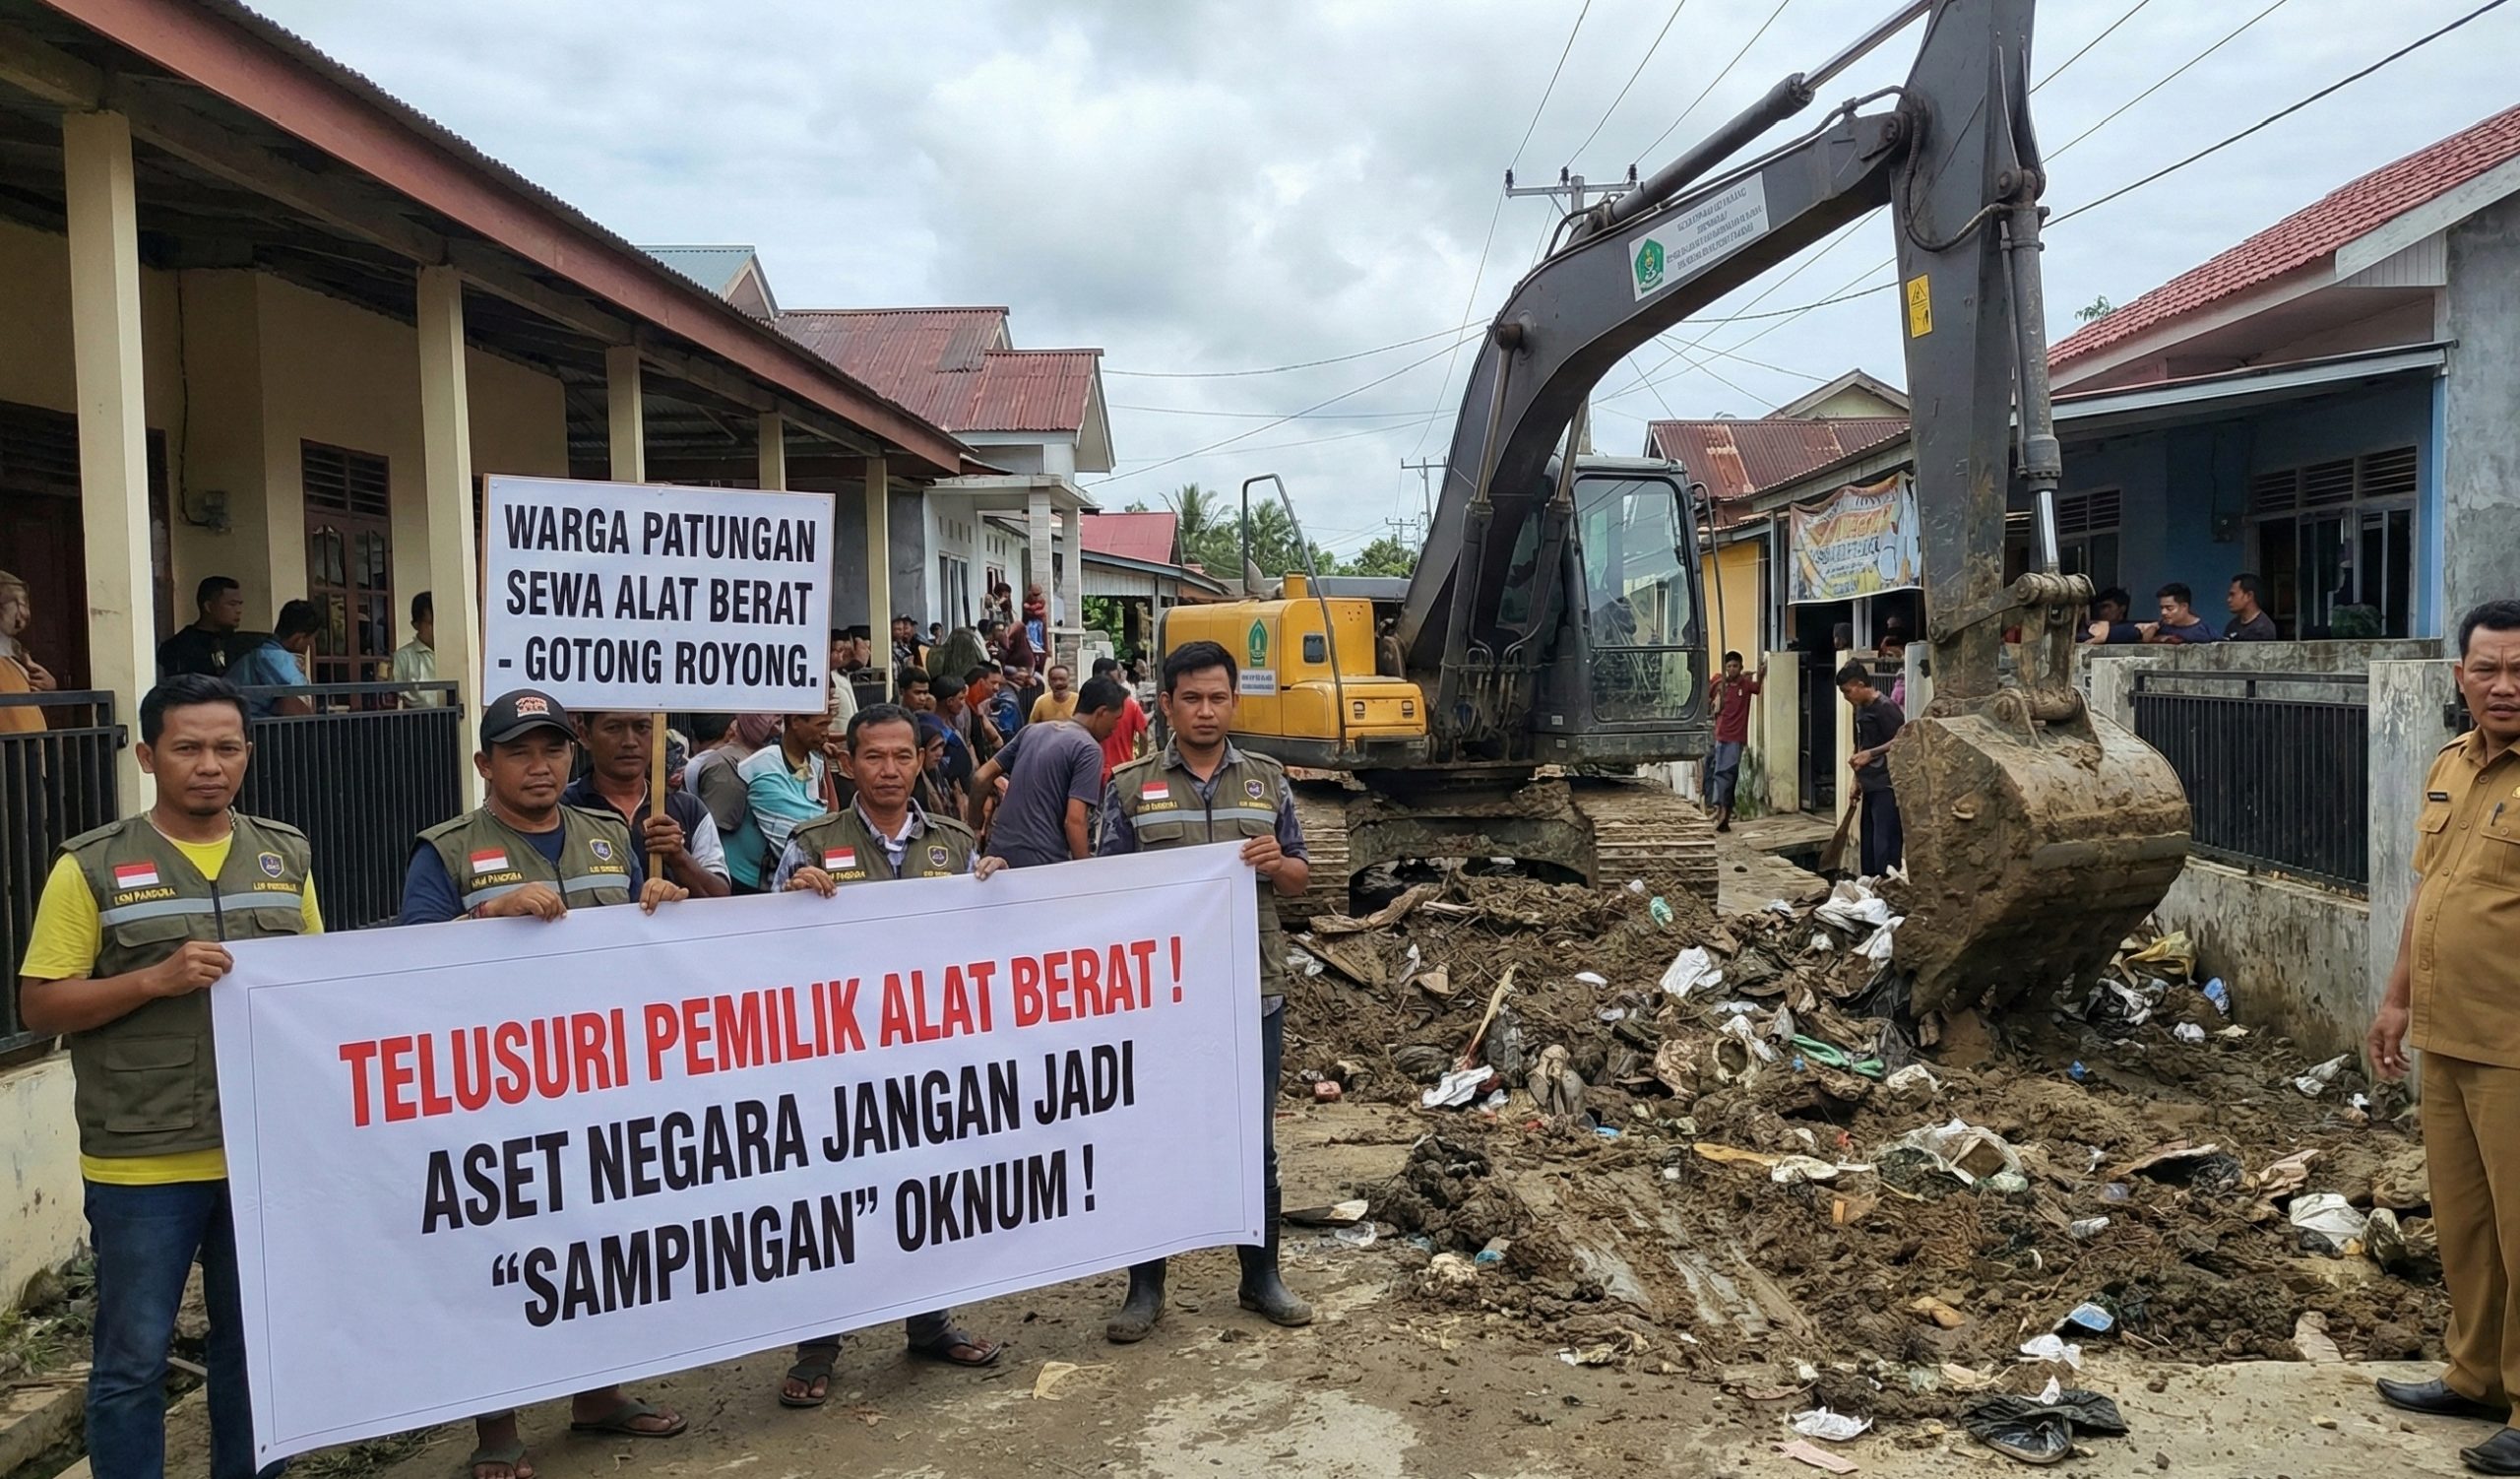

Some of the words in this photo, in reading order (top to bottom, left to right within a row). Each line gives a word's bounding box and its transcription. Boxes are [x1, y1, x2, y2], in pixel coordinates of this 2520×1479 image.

[504, 503, 630, 554] WARGA
[643, 511, 816, 563] PATUNGAN
[506, 568, 604, 619] SEWA
[614, 574, 699, 622] ALAT
[709, 578, 813, 626] BERAT
[525, 635, 662, 684] GOTONG
[674, 640, 818, 688] ROYONG.
[339, 1008, 629, 1127] TELUSURI
[644, 978, 865, 1081] PEMILIK
[879, 961, 996, 1046] ALAT
[1010, 939, 1157, 1028] BERAT
[1168, 935, 1182, 1002] !
[421, 1129, 569, 1235] ASET
[587, 1093, 810, 1205] NEGARA
[821, 1059, 1021, 1163] JANGAN
[1034, 1039, 1135, 1125] JADI
[491, 1186, 878, 1327] “SAMPINGAN”
[895, 1148, 1068, 1253] OKNUM
[1082, 1143, 1096, 1212] !
